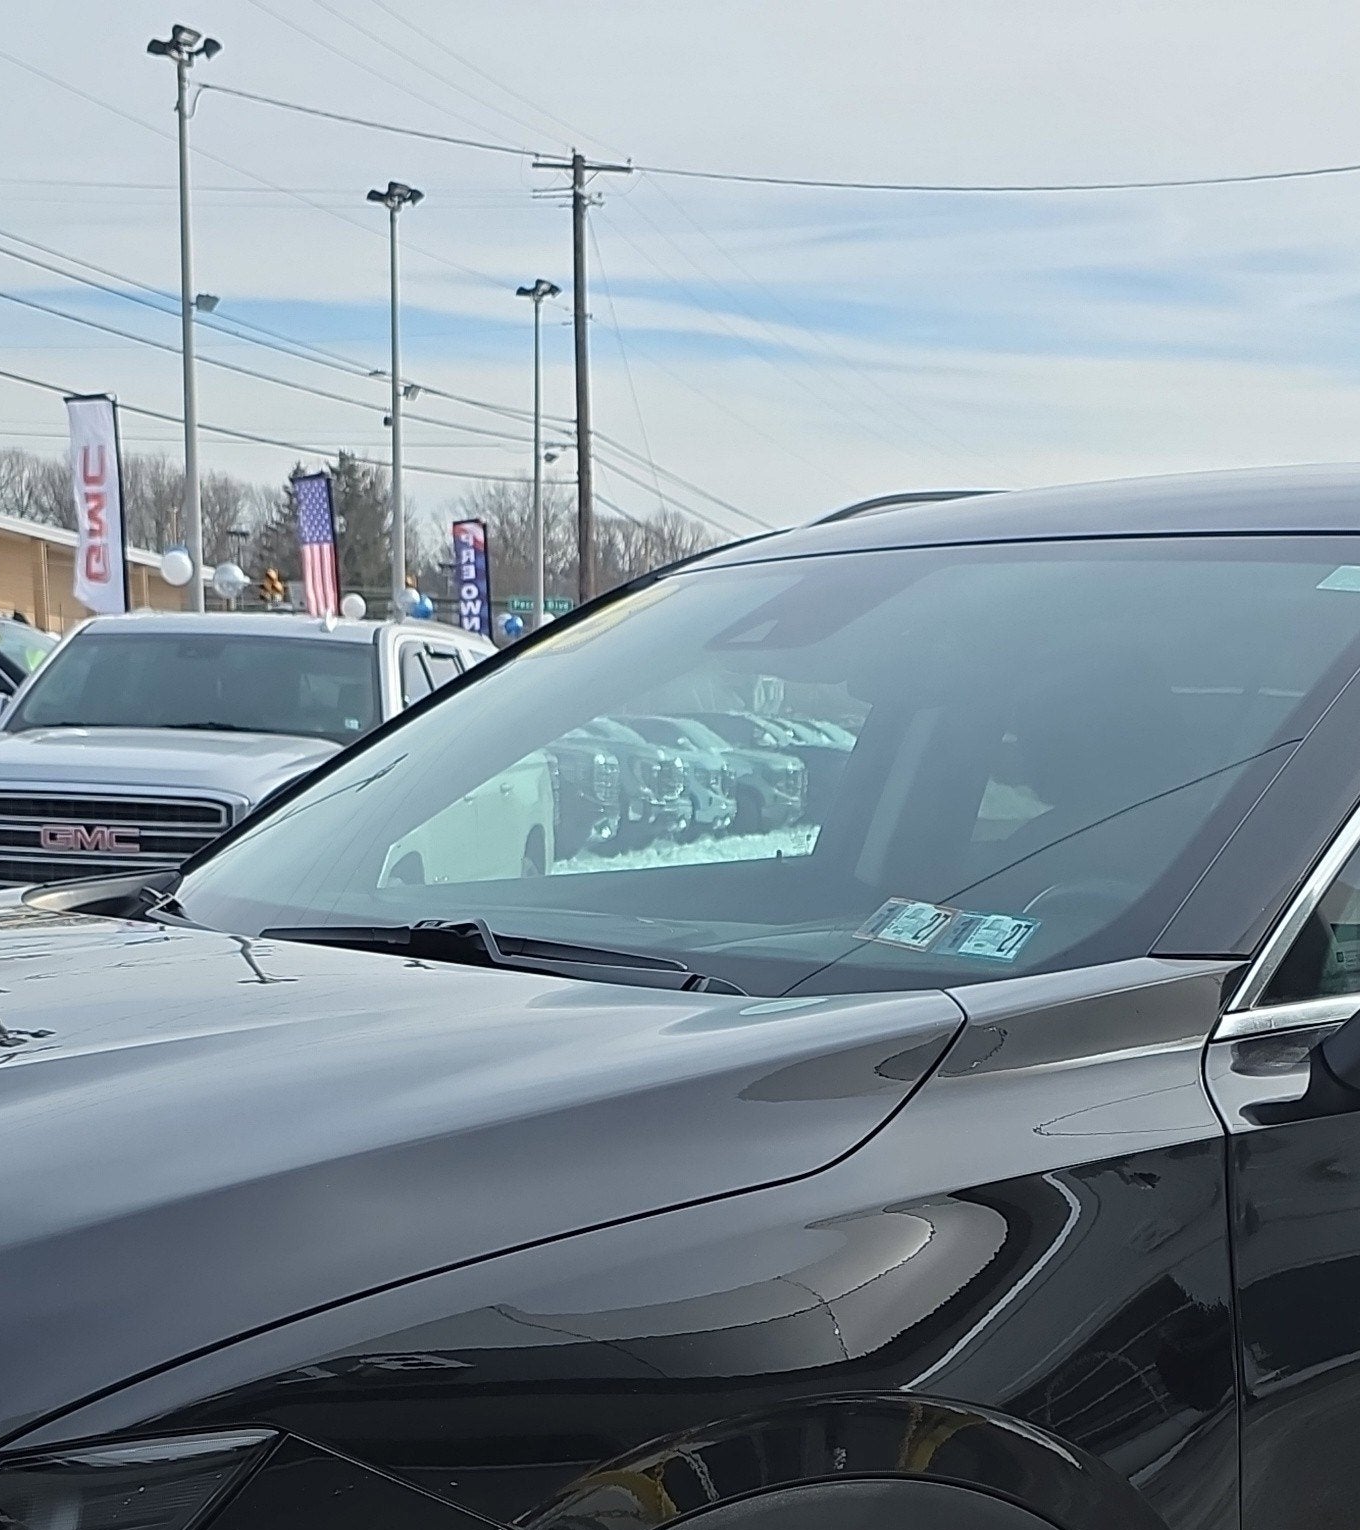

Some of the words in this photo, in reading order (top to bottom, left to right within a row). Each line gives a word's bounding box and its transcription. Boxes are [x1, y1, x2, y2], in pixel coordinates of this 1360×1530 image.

[41, 824, 140, 854] GMC
[911, 912, 951, 944] 27
[995, 923, 1034, 957] 27
